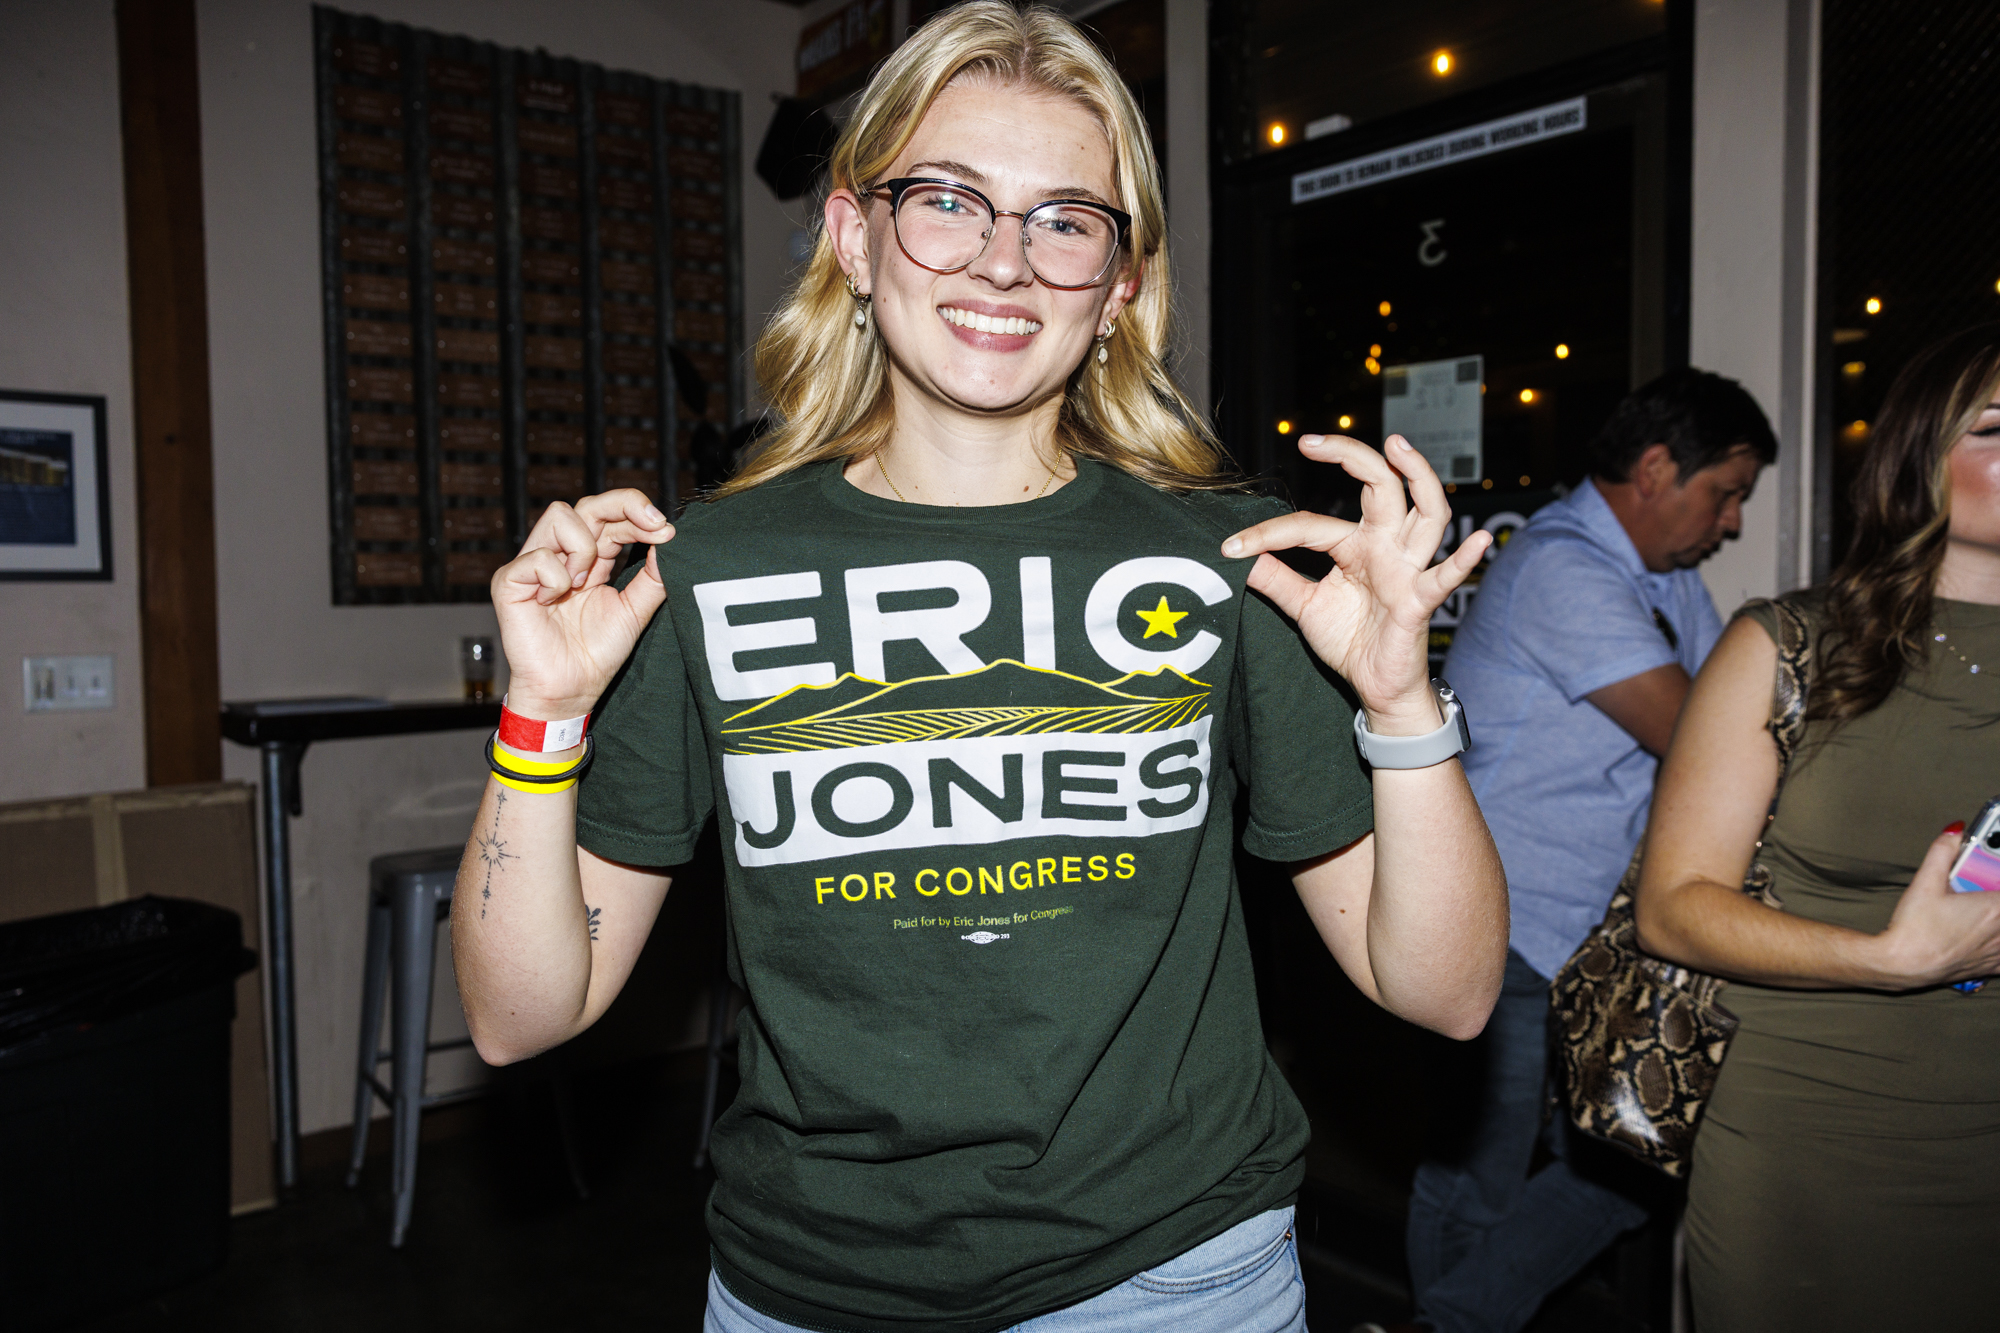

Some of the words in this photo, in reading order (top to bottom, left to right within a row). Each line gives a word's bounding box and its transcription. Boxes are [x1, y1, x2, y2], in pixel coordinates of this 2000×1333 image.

[1544, 108, 1580, 130] HOURS
[693, 556, 1233, 702] ERIC
[741, 738, 1202, 850] JONES
[815, 871, 897, 904] FOR
[915, 852, 1136, 897] CONGRESS
[893, 917, 919, 930] Paid
[921, 916, 937, 927] for
[938, 916, 951, 928] by
[953, 916, 975, 927] Eric
[977, 915, 1011, 927] Jones
[1013, 912, 1029, 924] for
[1030, 905, 1074, 920] Congress
